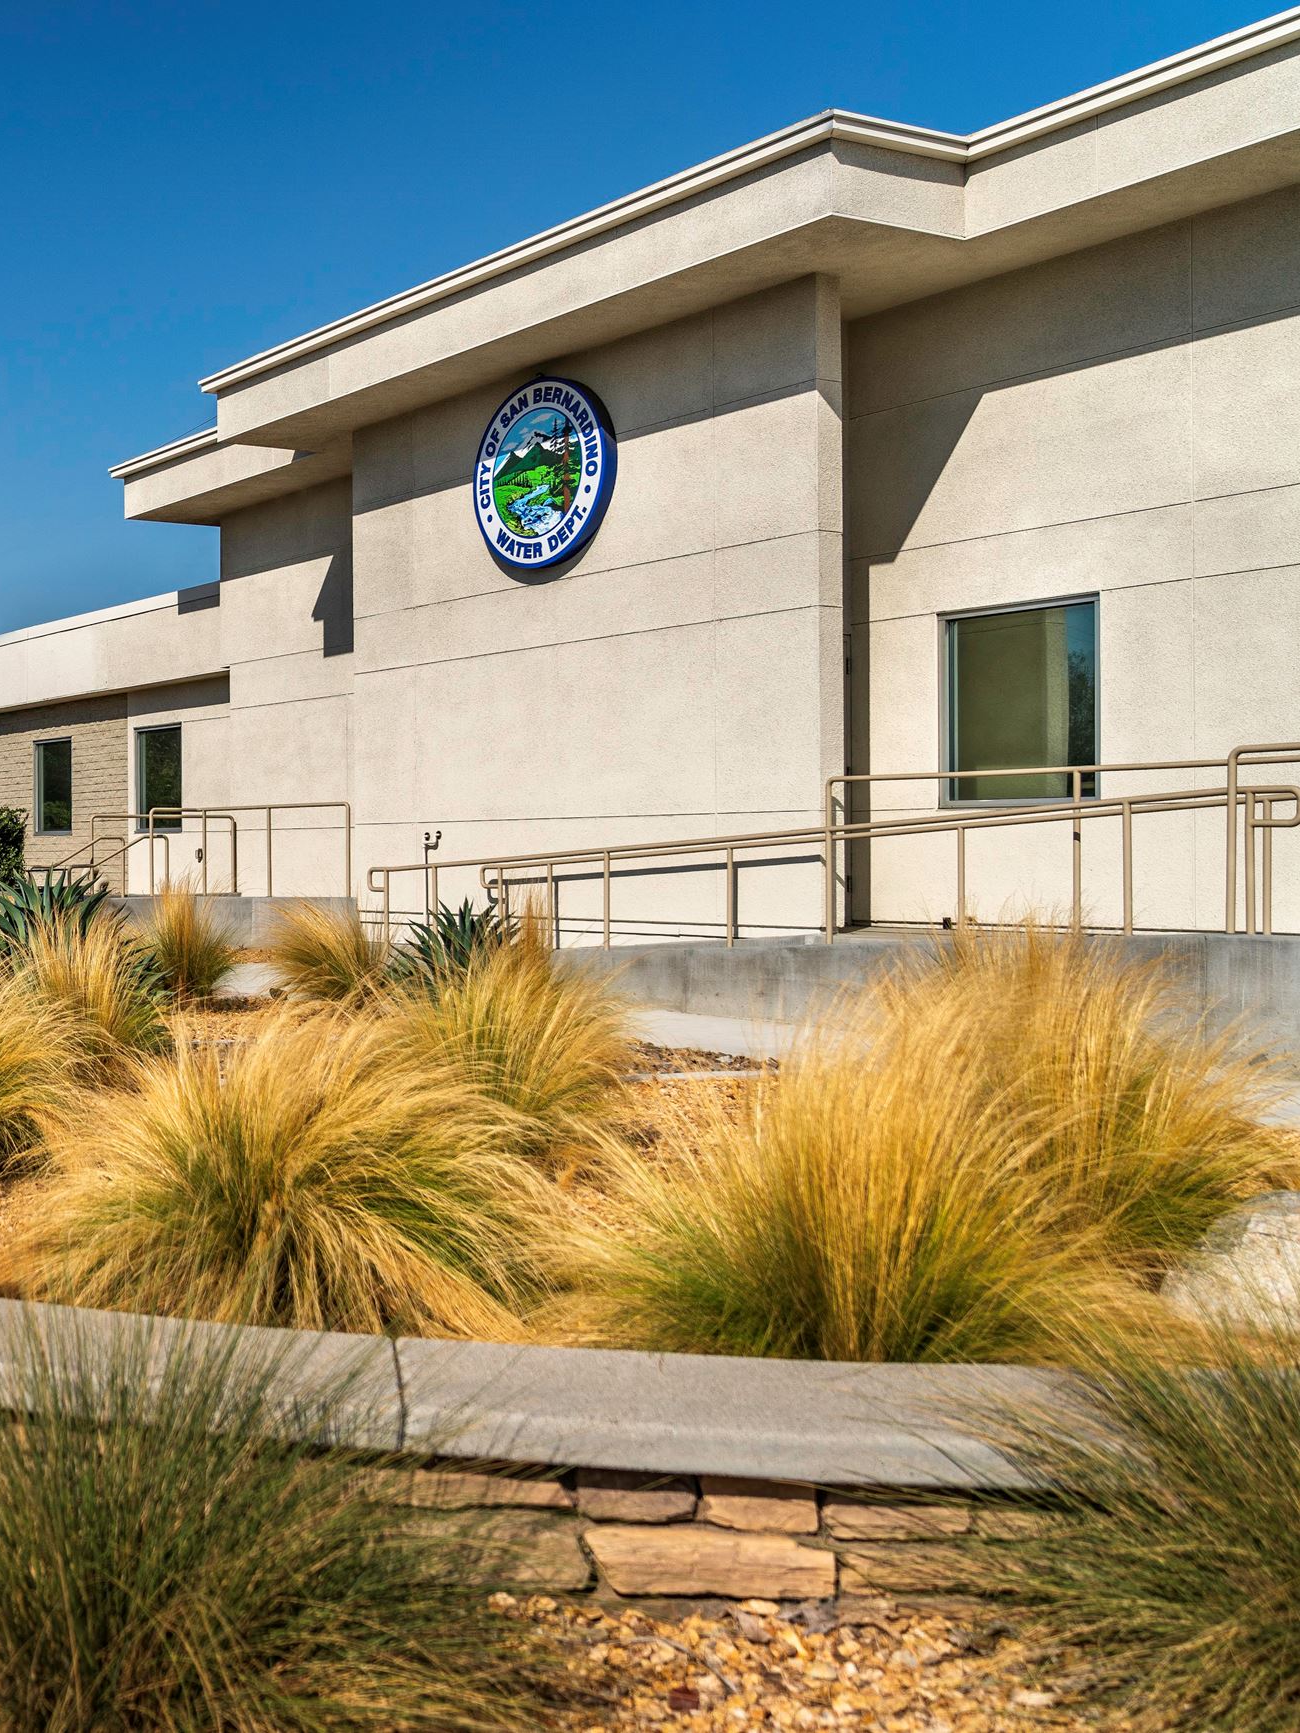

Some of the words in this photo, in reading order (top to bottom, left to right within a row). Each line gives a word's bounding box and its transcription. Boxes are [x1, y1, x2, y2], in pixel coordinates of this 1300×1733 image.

[502, 394, 529, 428] SAN
[533, 386, 598, 477] BERNARDINO
[485, 428, 500, 457] OF
[479, 463, 492, 510] CITY
[496, 528, 543, 559] WATER
[549, 506, 587, 553] DEPT.
